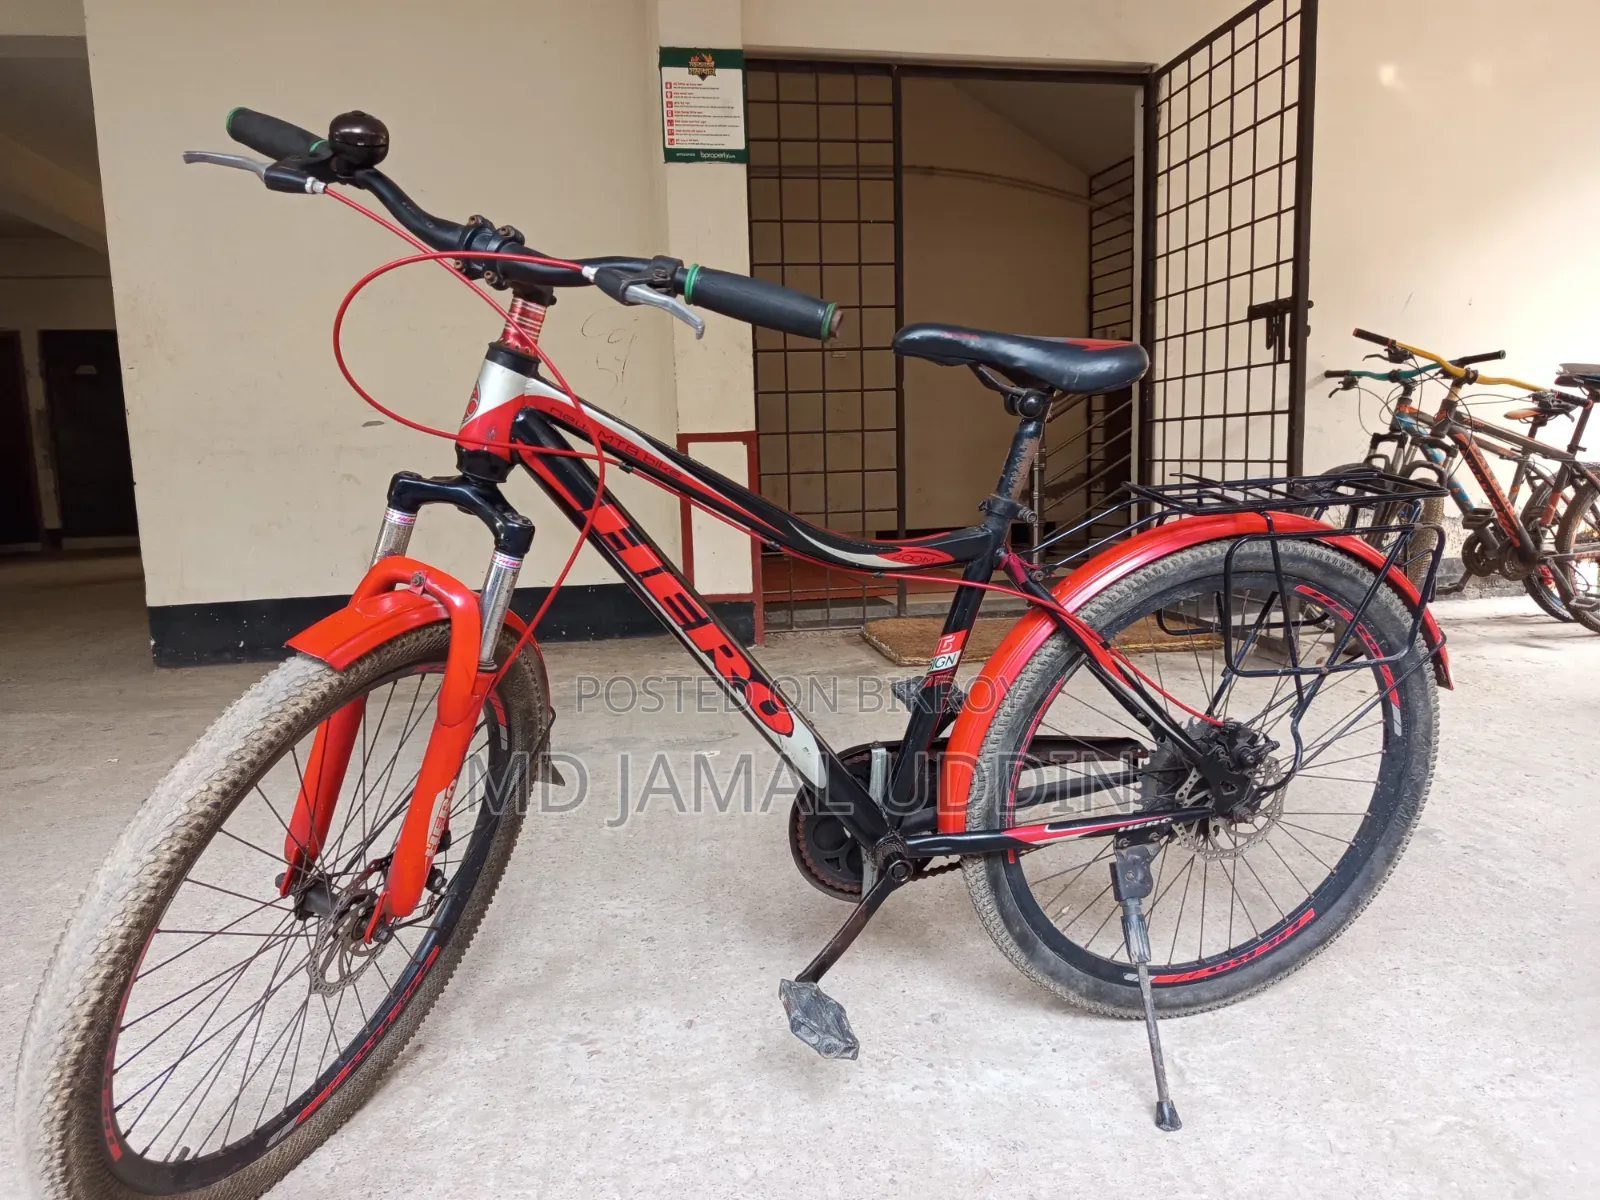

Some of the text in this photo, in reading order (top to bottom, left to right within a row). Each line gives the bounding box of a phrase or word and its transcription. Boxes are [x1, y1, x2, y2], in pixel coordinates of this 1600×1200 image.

[643, 454, 682, 478] bike
[892, 554, 936, 564] ZOOM
[582, 503, 794, 737] HERO
[425, 778, 457, 857] HERO
[1118, 817, 1173, 832] HERO
